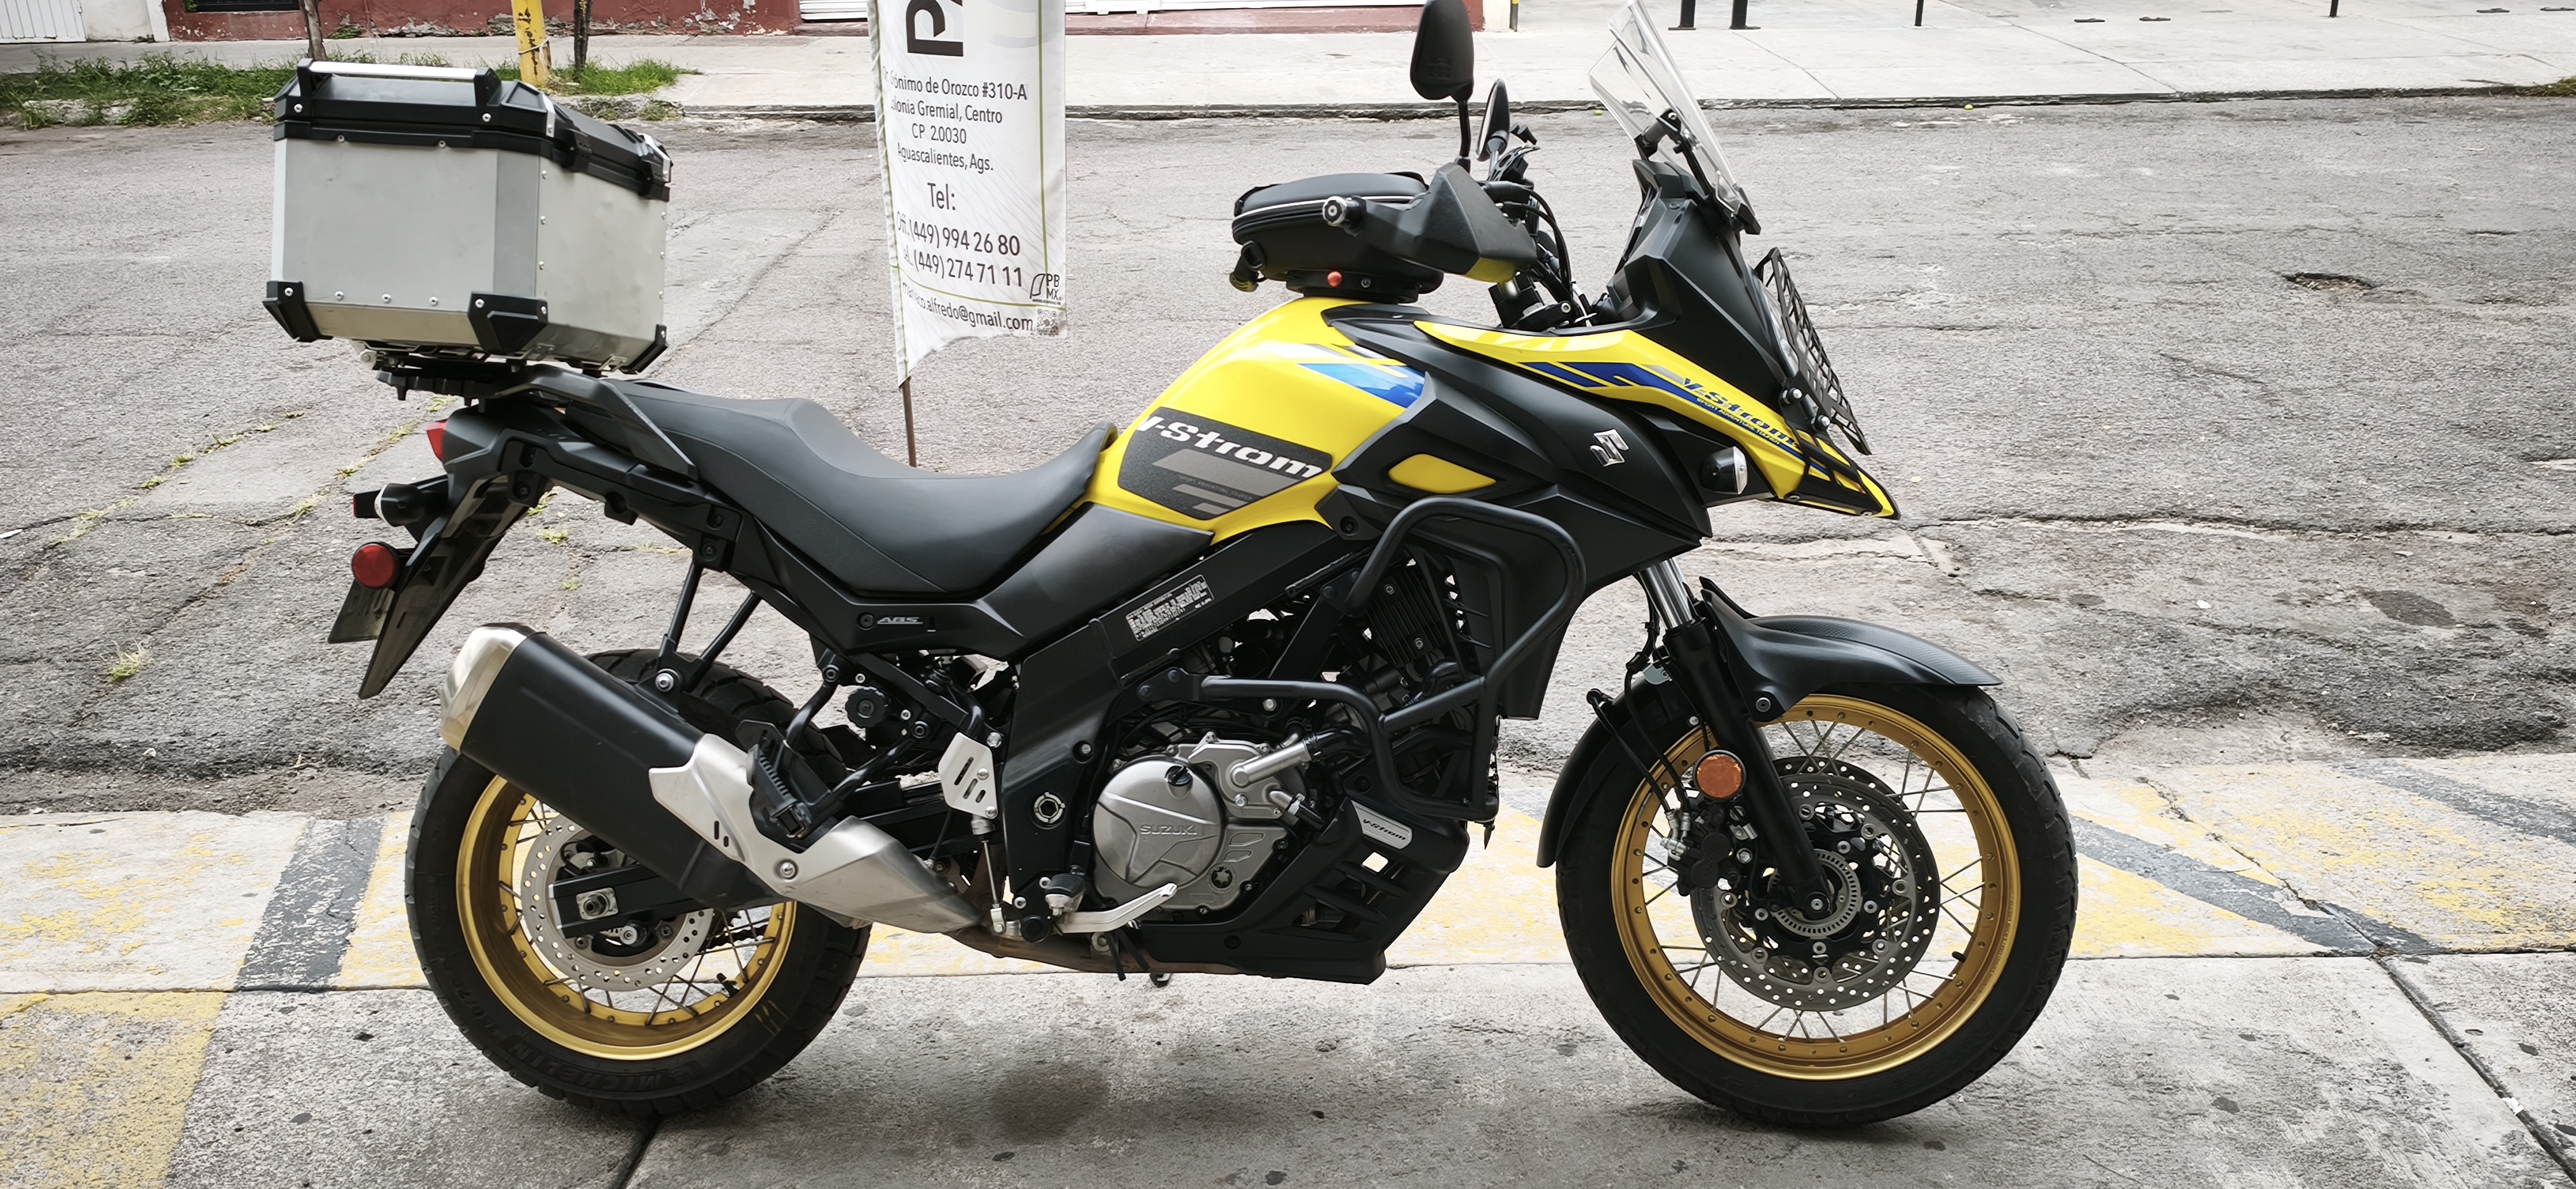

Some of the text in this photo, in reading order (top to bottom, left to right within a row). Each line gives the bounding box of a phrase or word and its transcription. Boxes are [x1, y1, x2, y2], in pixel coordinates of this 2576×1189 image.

[906, 0, 963, 57] P
[925, 76, 939, 93] de
[941, 78, 979, 97] Orozco
[983, 83, 1028, 100] #310-A
[890, 95, 1003, 124] olonia Gremial, Centro
[911, 123, 925, 139] CP
[897, 142, 993, 174] Aguascalientes, Ags.
[927, 182, 956, 210] Tel:
[909, 219, 939, 248] (449)
[943, 227, 970, 250] 994
[973, 231, 993, 253] 26
[998, 235, 1021, 255] 80
[915, 249, 944, 279] (449)
[947, 258, 974, 281] 274
[977, 263, 996, 285] 71
[1002, 266, 1022, 286] 11
[1046, 273, 1060, 288] PB
[1682, 377, 1799, 447] V-Strom
[877, 616, 922, 624] ABS
[1140, 824, 1205, 836] SUZUK
